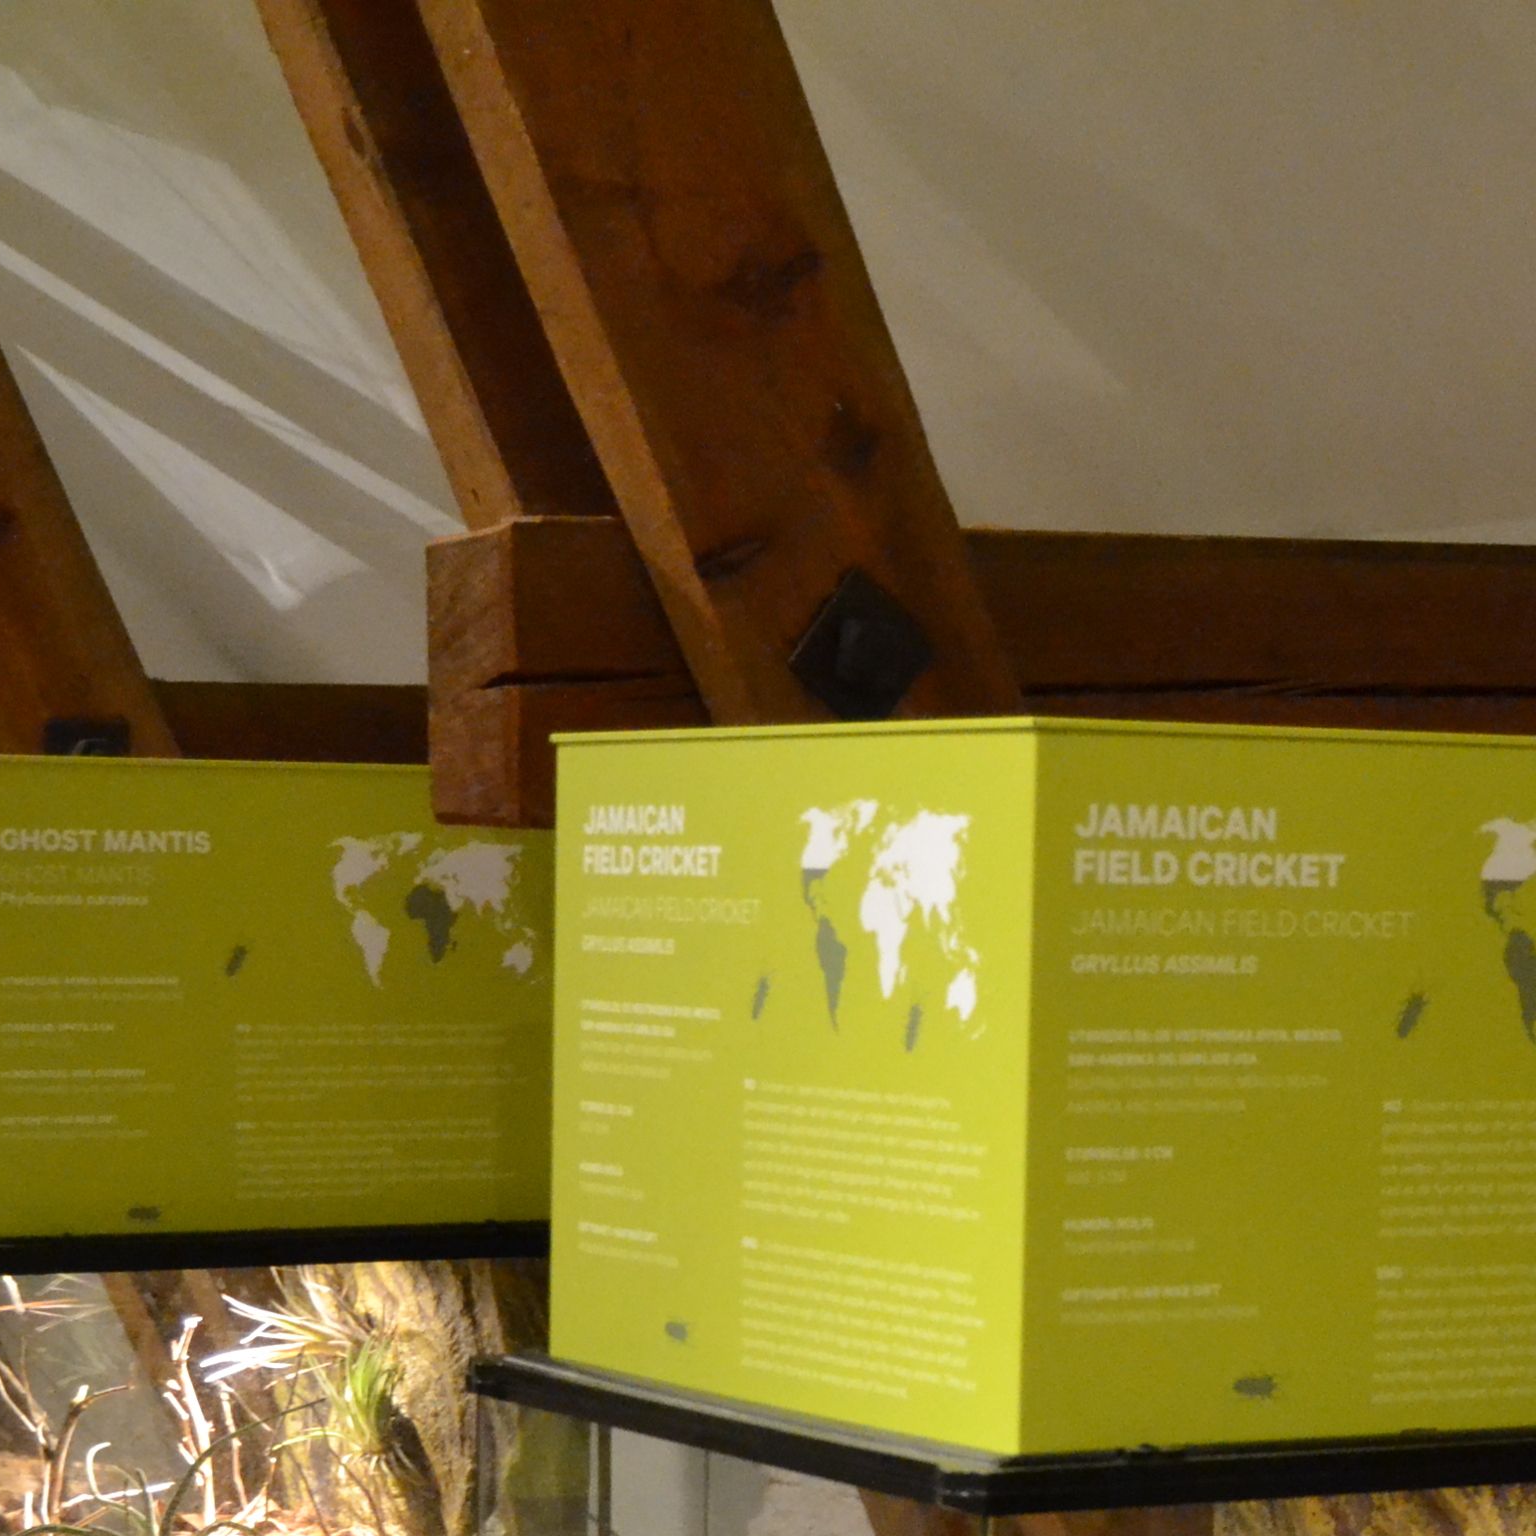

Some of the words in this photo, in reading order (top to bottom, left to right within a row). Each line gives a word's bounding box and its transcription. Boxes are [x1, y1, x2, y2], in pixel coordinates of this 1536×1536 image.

[583, 804, 686, 836] JAMAICAN
[1075, 803, 1278, 841] JAMAICAN
[0, 828, 97, 852] GHOST
[103, 829, 211, 854] MANTIS
[583, 844, 634, 875] FIELD
[638, 844, 722, 878] CRICKET
[1073, 848, 1180, 885] FIELD
[1187, 850, 1345, 888] CRICKET
[1071, 908, 1215, 937] JAMAICAN
[1222, 909, 1300, 938] FIELD
[1303, 910, 1416, 941] CRICKET
